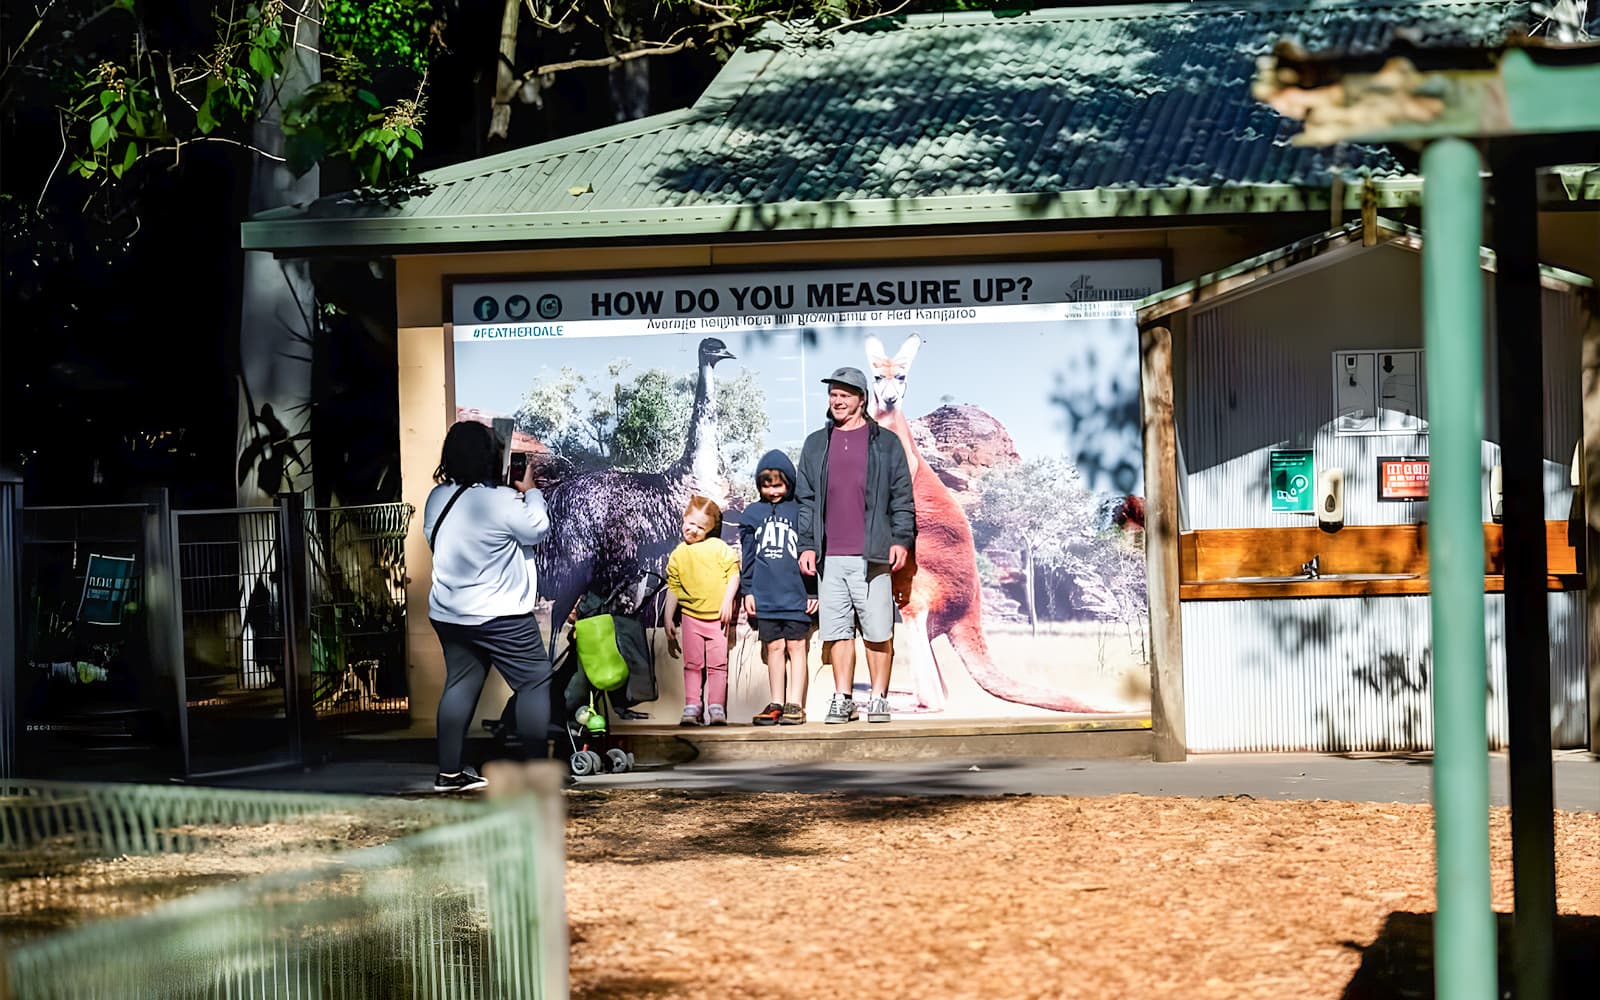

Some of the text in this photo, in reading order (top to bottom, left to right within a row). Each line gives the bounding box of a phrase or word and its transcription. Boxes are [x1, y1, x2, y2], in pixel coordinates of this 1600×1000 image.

[591, 277, 1033, 316] HOW DO YOU MEASURE UP?
[870, 311, 883, 321] or
[887, 309, 911, 321] Red
[916, 308, 977, 322] Kangaroo
[473, 325, 564, 338] #FEATHERDALE
[754, 521, 798, 559] CATS
